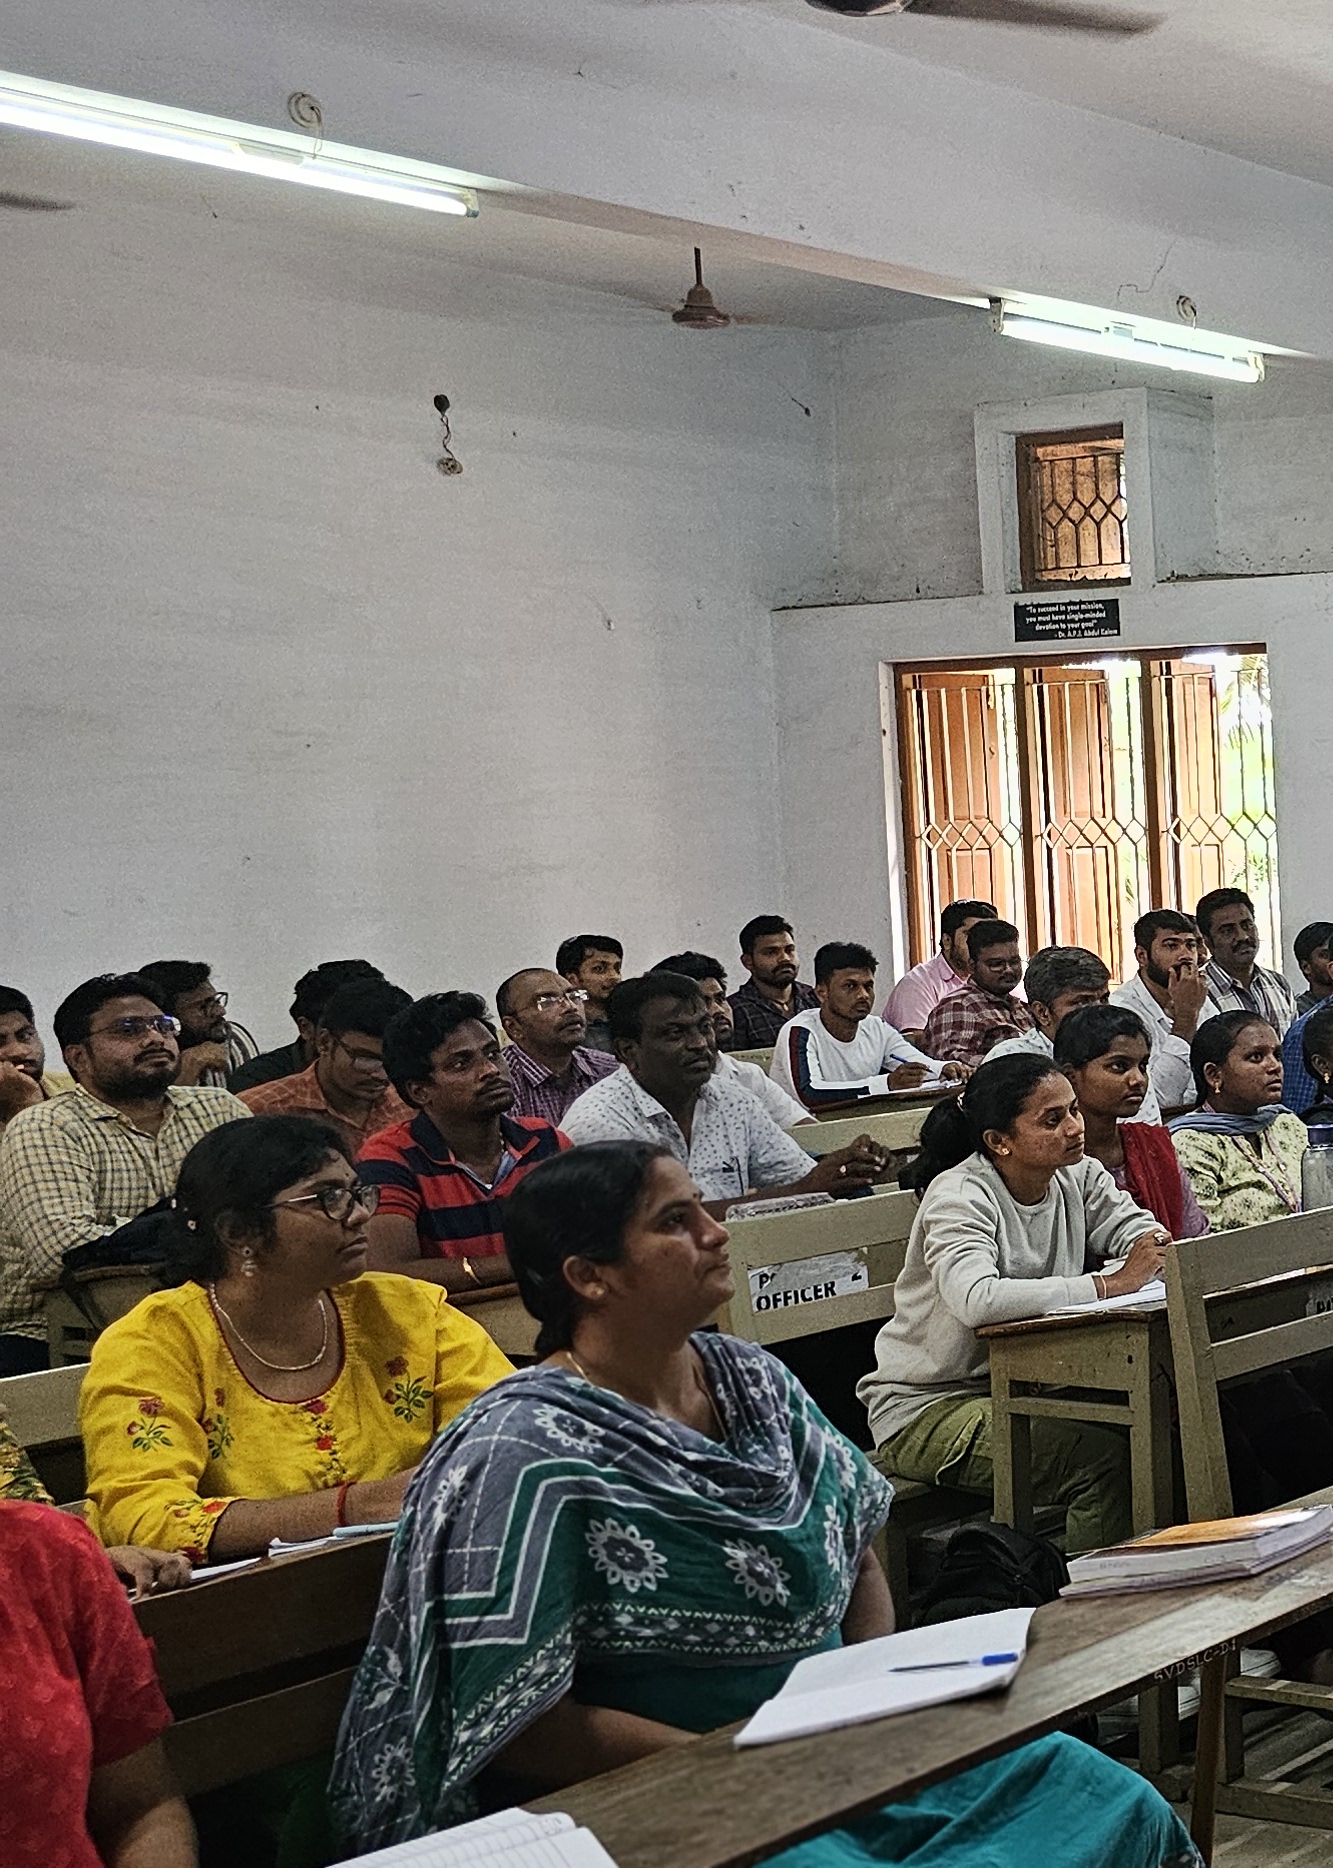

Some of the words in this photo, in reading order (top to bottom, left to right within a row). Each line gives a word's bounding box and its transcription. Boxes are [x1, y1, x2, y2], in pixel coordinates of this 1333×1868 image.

[1051, 613, 1066, 621] have
[1067, 622, 1080, 630] your
[1084, 628, 1100, 637] Abdul
[756, 1280, 837, 1312] OFFICER
